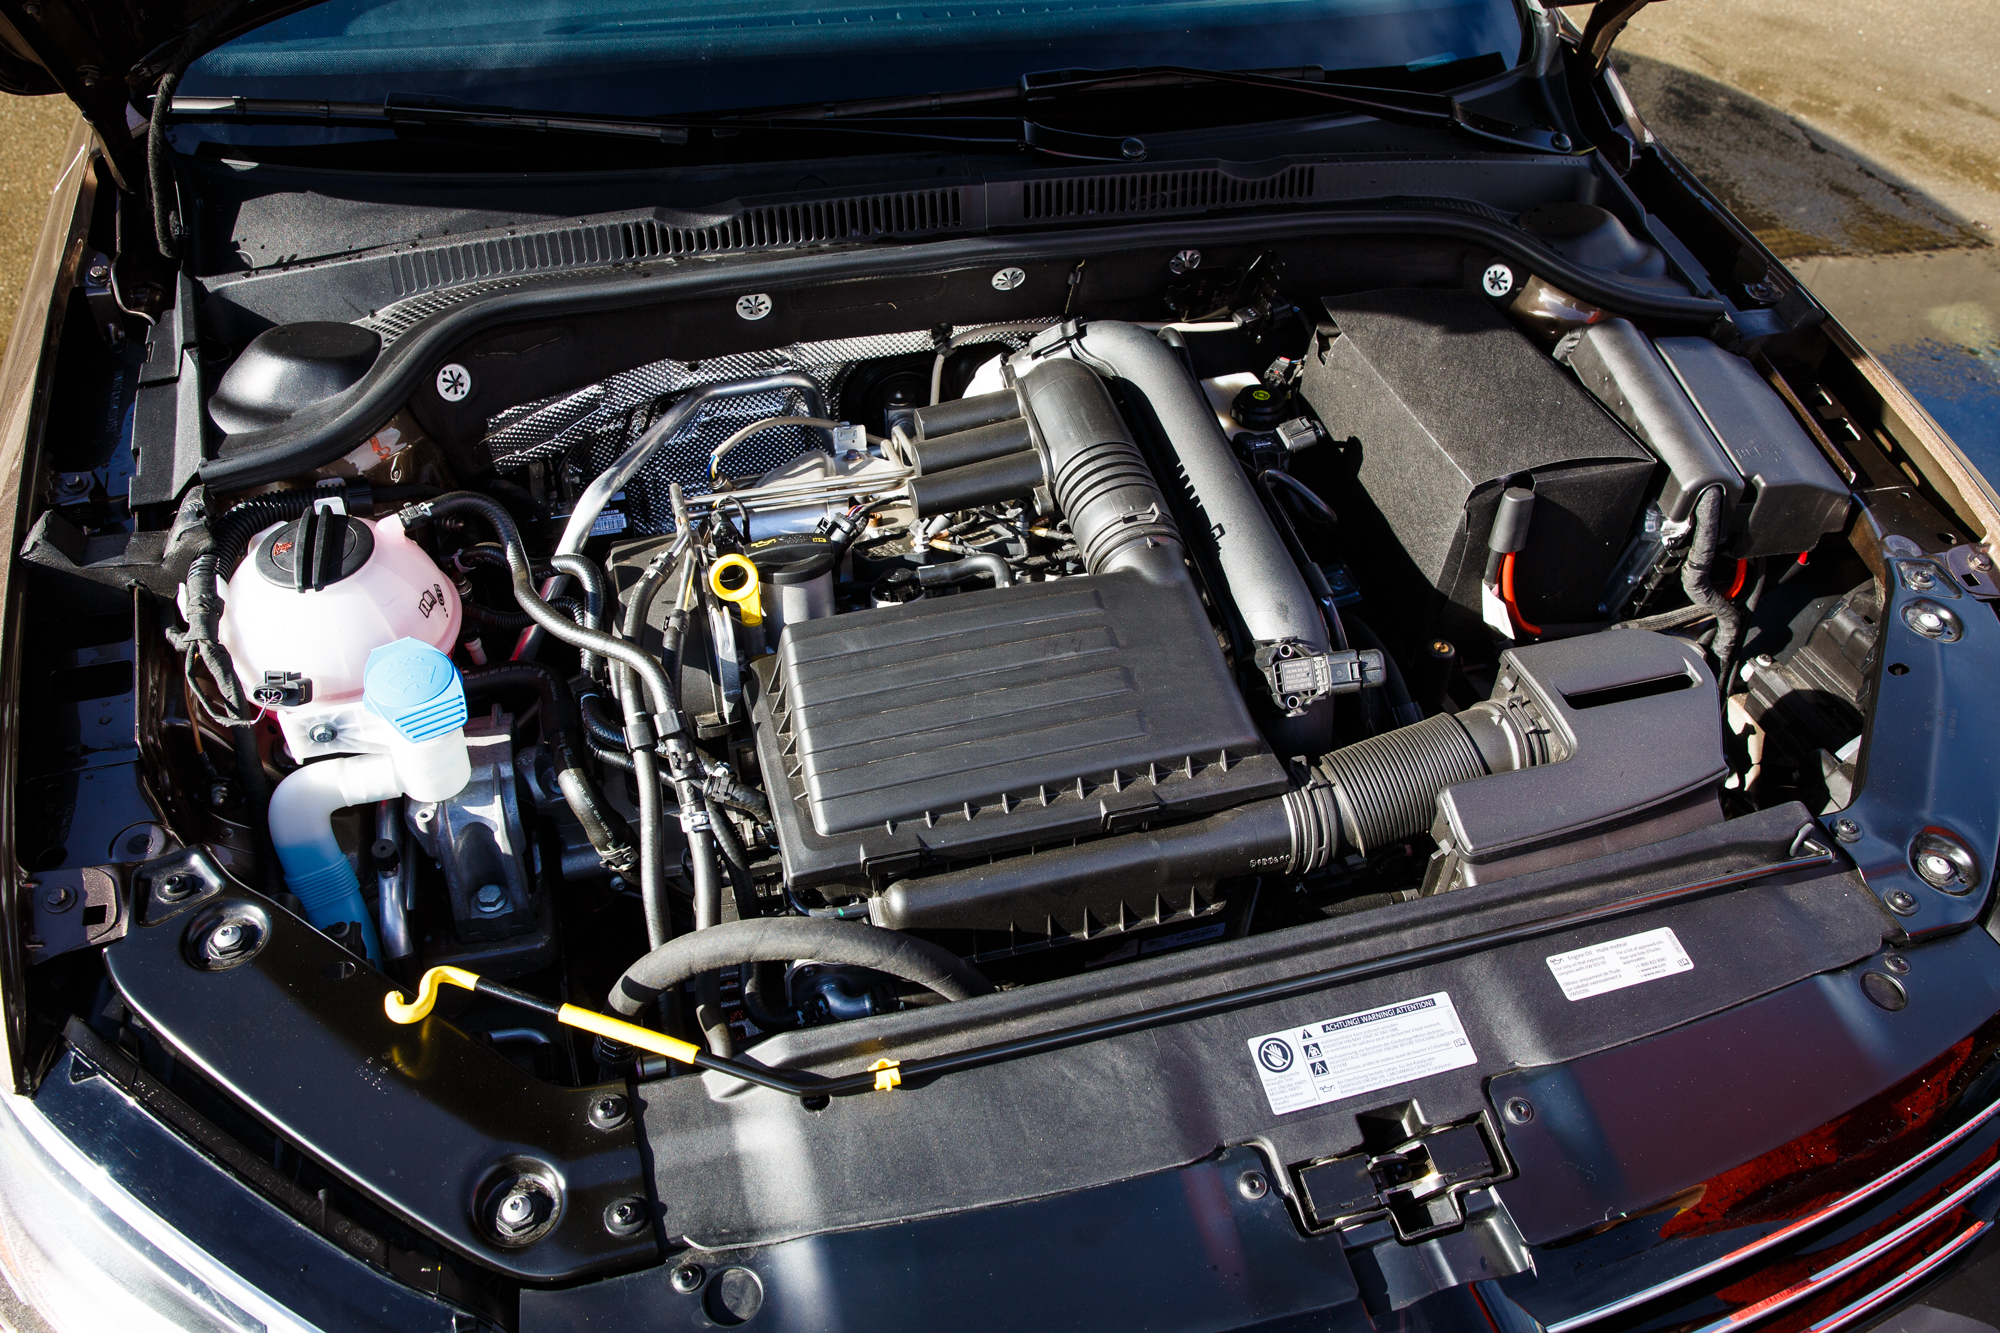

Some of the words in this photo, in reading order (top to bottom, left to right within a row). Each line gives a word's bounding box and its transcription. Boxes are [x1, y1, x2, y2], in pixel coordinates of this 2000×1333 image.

[585, 796, 595, 809] 122
[1638, 942, 1657, 950] approved
[1567, 953, 1585, 961] Engine
[1325, 1018, 1360, 1031] ACHTUNG!
[1360, 1009, 1395, 1022] WARNING!
[1396, 1000, 1434, 1014] ATTENTION!
[1415, 1035, 1436, 1043] TOUCHING
